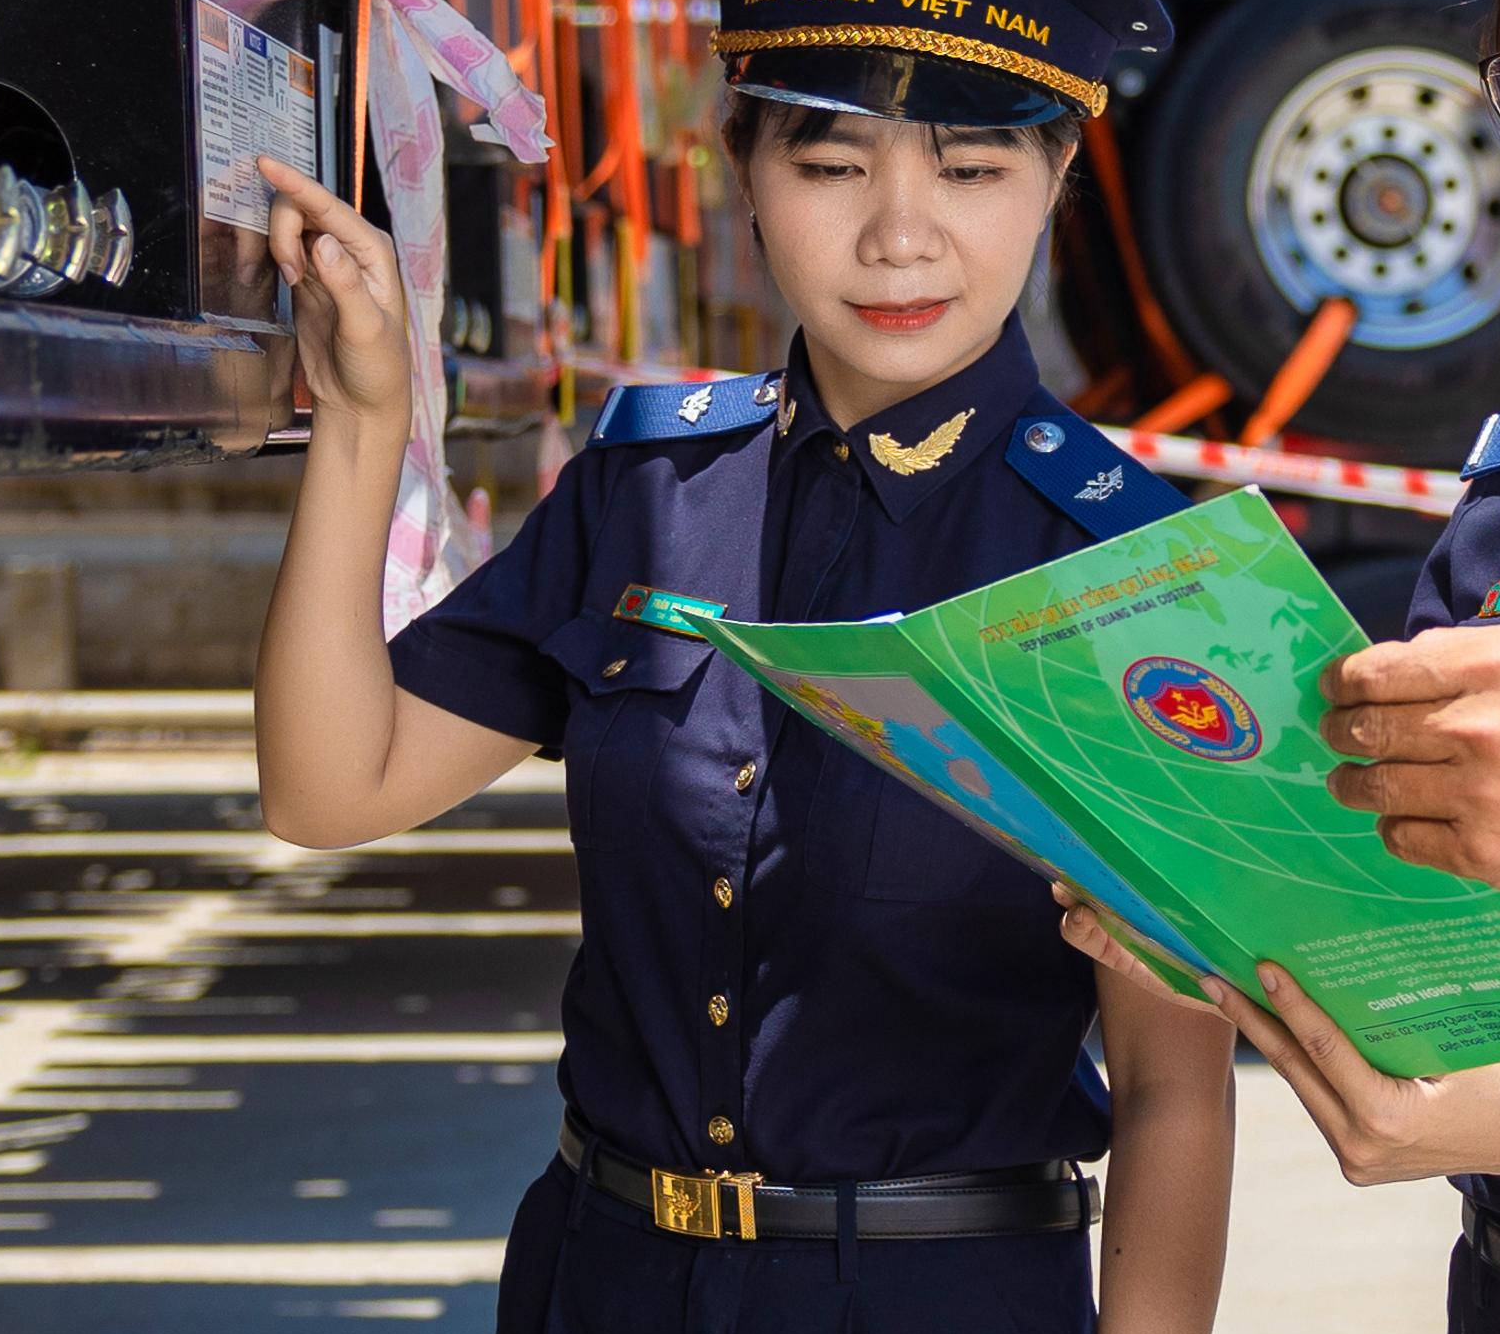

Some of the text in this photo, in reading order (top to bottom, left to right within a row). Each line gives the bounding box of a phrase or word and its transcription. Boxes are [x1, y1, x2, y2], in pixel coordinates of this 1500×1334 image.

[984, 4, 1051, 47] NAM
[1019, 581, 1204, 651] DEPARTMENT OF QUANG NGAI CUSTOMS
[1367, 992, 1418, 1011] CHUYÊN
[1416, 982, 1462, 999] NGHIỆP
